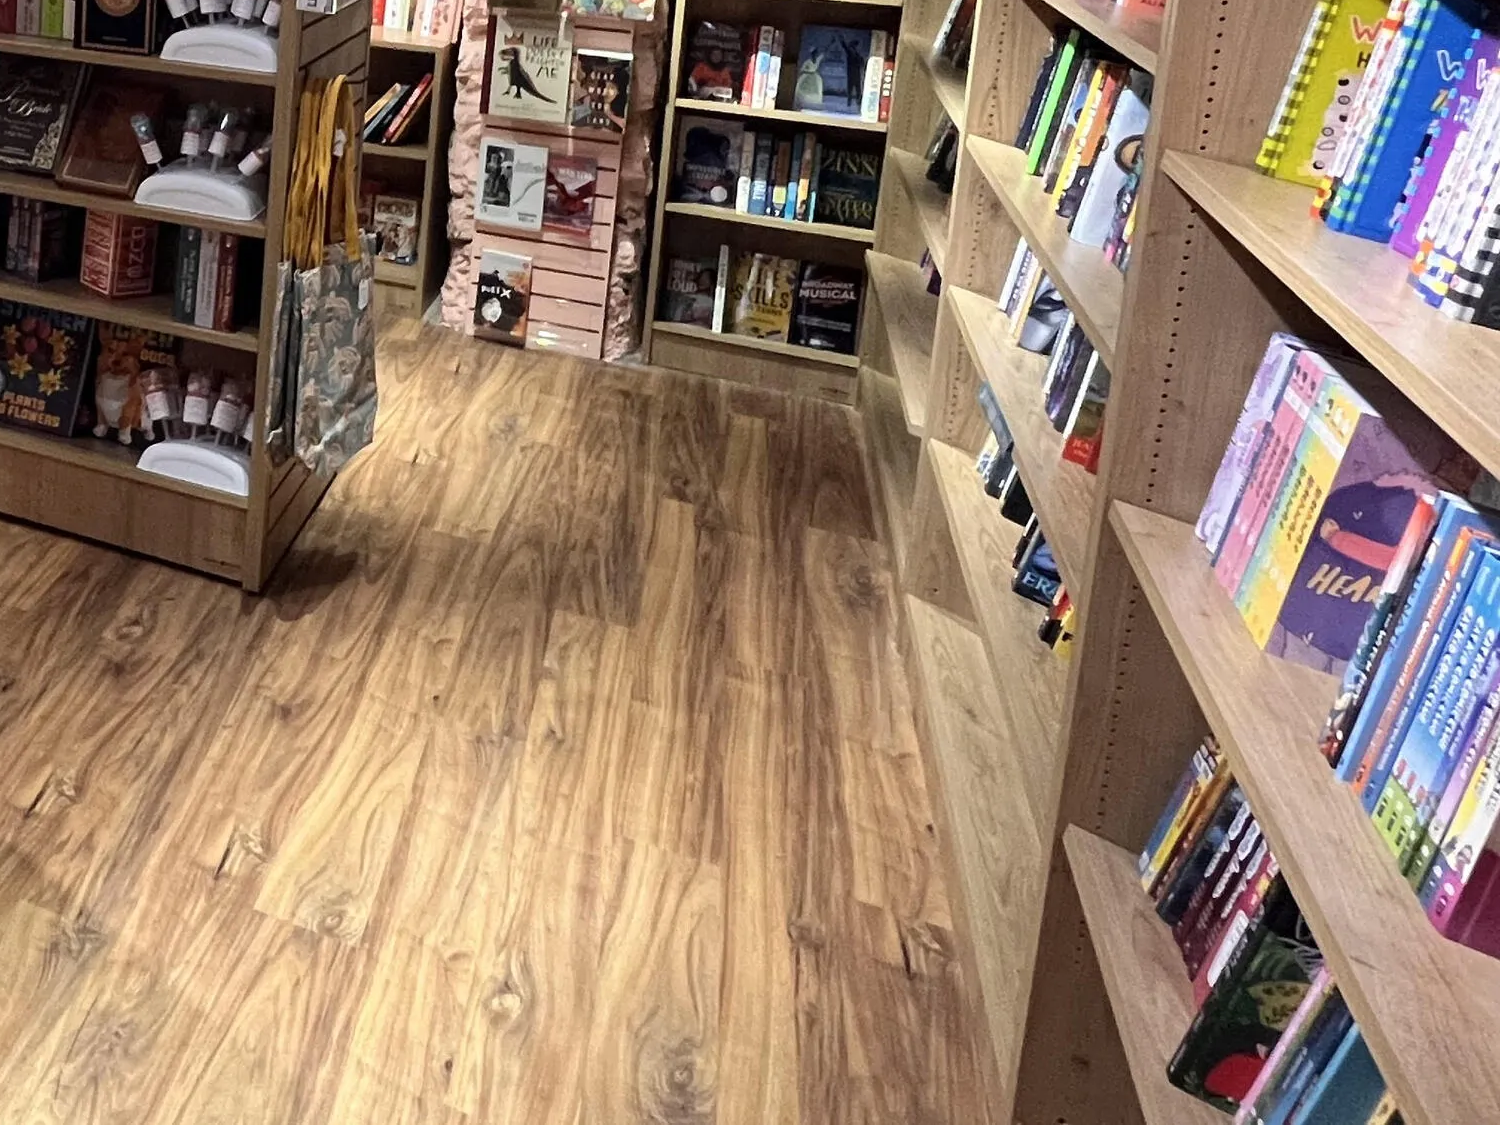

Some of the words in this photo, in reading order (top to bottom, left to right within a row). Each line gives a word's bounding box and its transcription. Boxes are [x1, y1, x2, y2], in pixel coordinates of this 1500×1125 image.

[733, 284, 790, 308] SILLS
[799, 288, 857, 301] MUSICAL
[3, 391, 47, 411] PLANTS
[6, 403, 61, 428] FLOWERS
